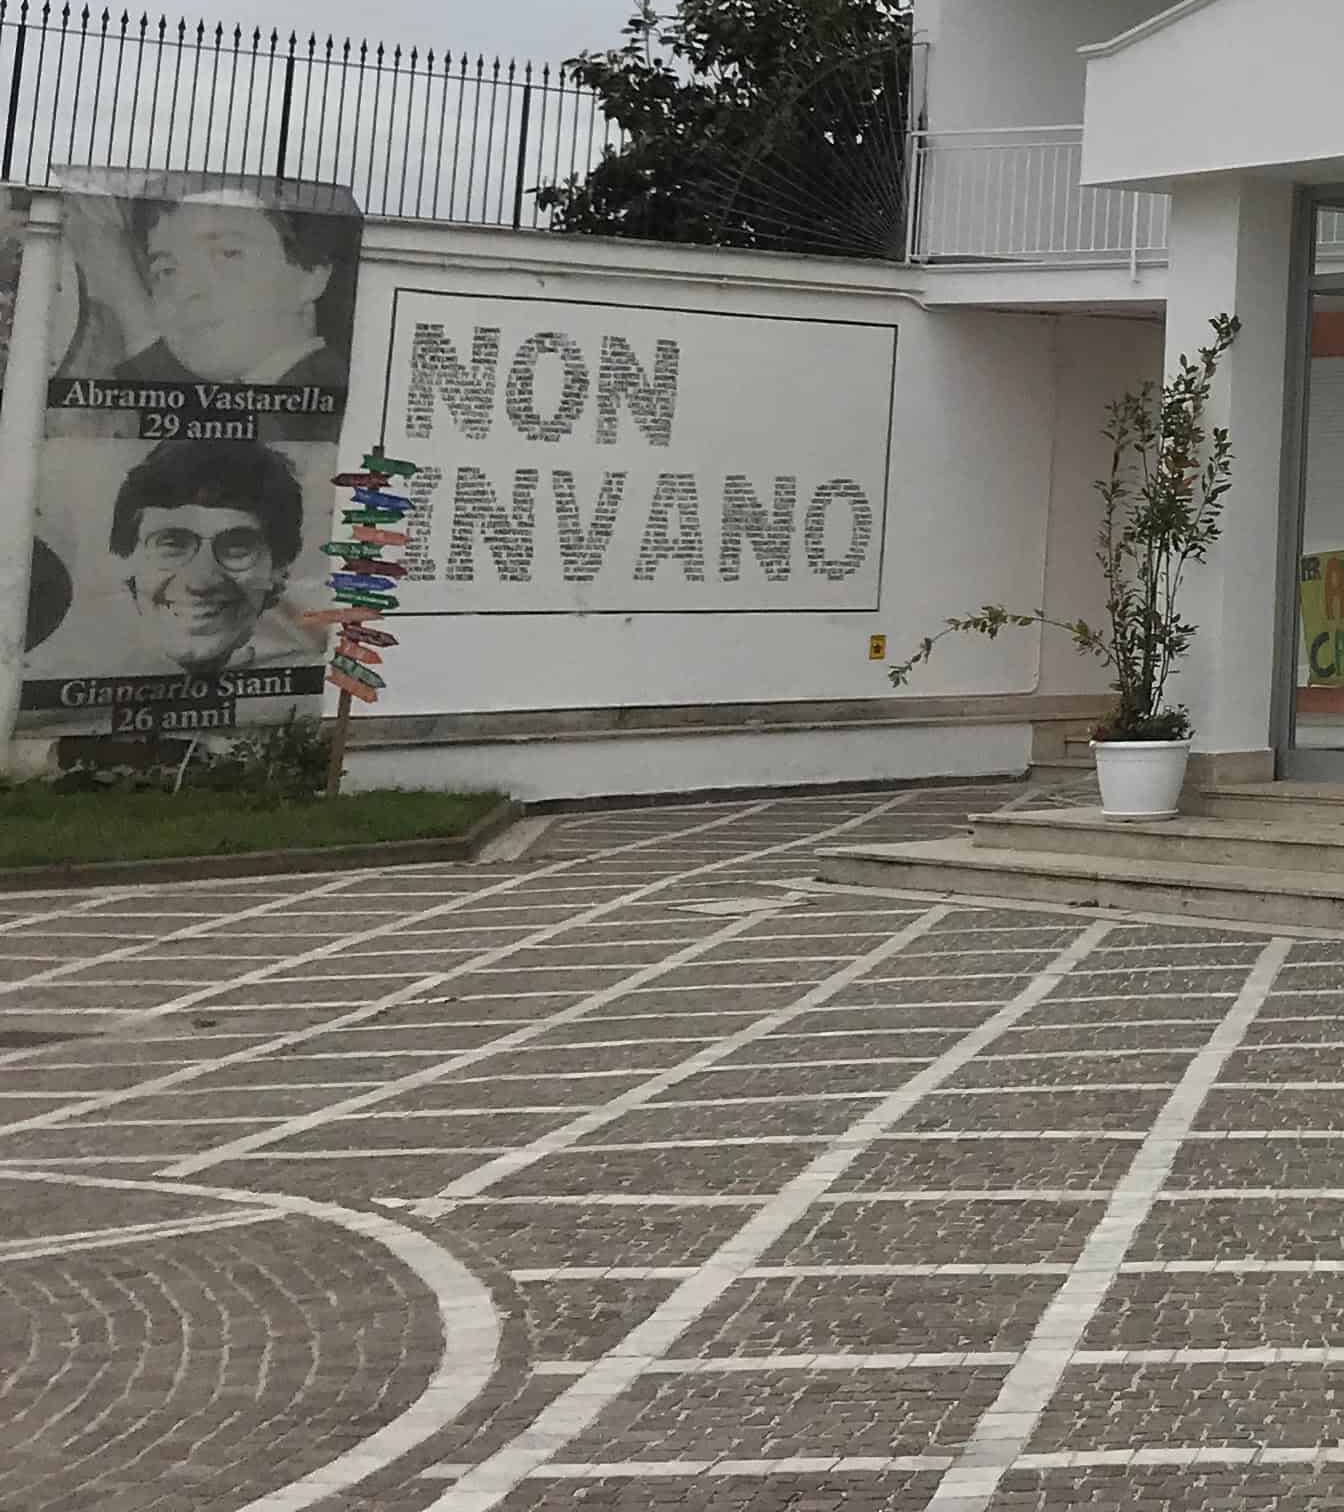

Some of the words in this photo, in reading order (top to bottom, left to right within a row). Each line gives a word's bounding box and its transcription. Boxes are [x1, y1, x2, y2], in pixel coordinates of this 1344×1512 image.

[62, 381, 185, 409] Abramo
[195, 385, 337, 412] Vastarella
[405, 322, 680, 446] NON
[143, 414, 180, 438] 29
[186, 415, 255, 439] anni
[398, 466, 874, 583] INVANO
[60, 674, 207, 706] Giancarlo
[217, 670, 293, 697] Siani
[117, 707, 152, 731] 26
[161, 703, 232, 730] anni
